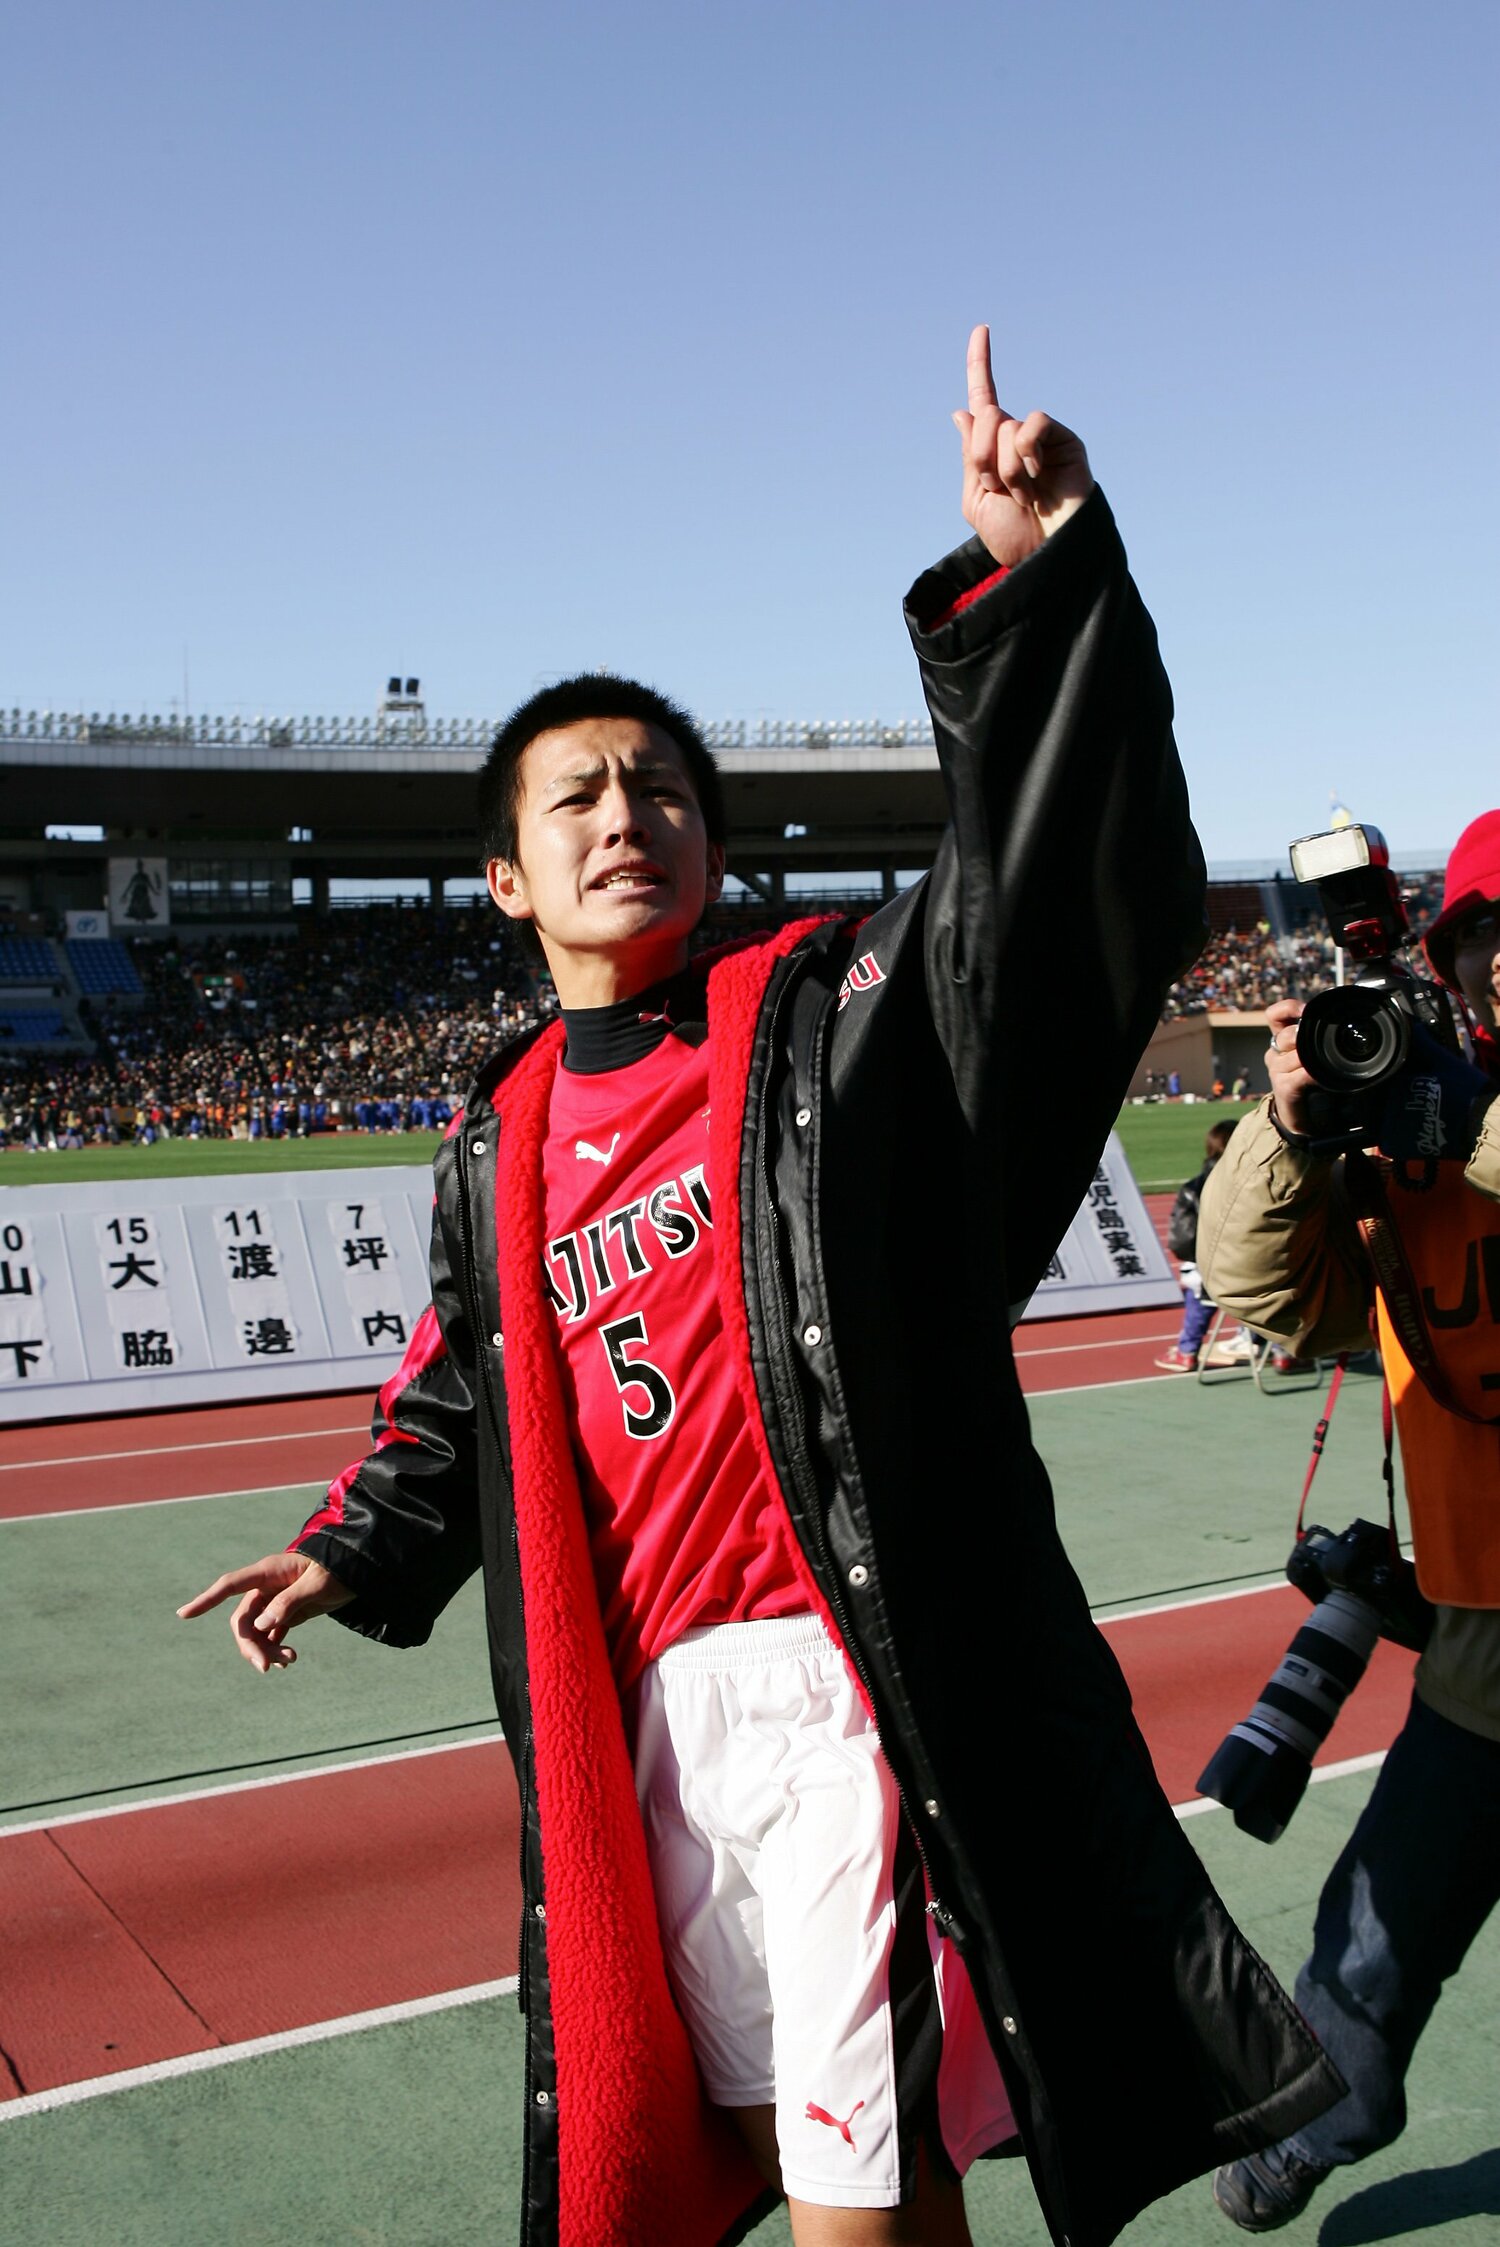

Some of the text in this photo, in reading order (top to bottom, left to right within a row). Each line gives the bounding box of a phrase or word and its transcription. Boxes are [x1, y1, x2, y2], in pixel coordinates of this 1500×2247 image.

[107, 1217, 149, 1246] 15
[224, 1210, 263, 1238] 11
[346, 1205, 366, 1231] 7
[1360, 1206, 1396, 1291] PROFESSION
[109, 1252, 173, 1367] 大脇
[343, 1237, 407, 1347] 坪内
[598, 1310, 677, 1441] 5
